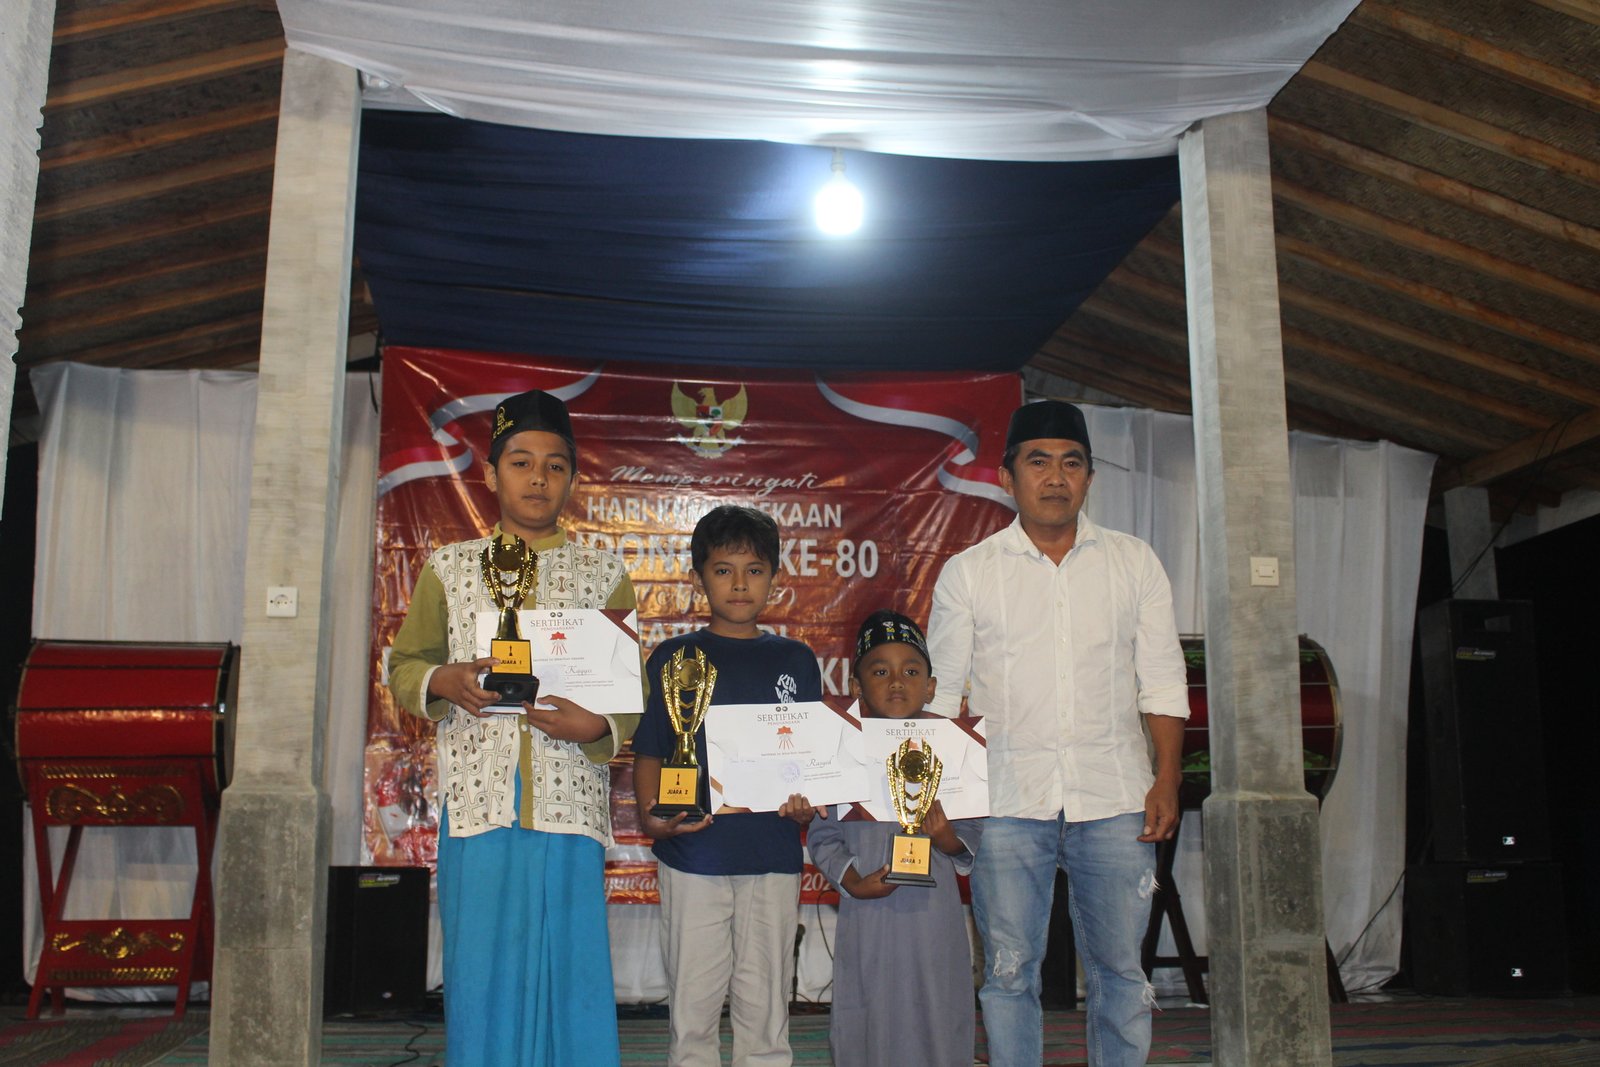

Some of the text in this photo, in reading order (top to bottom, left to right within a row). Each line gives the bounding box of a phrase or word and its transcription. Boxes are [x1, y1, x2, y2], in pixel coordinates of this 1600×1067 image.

[610, 465, 821, 497] Memperingati
[587, 496, 648, 521] HARI
[779, 538, 879, 579] KE-80
[530, 618, 584, 627] SERTIFIKAT
[757, 712, 809, 722] SERTIFIKAT
[885, 728, 936, 737] SERTIFIKAT
